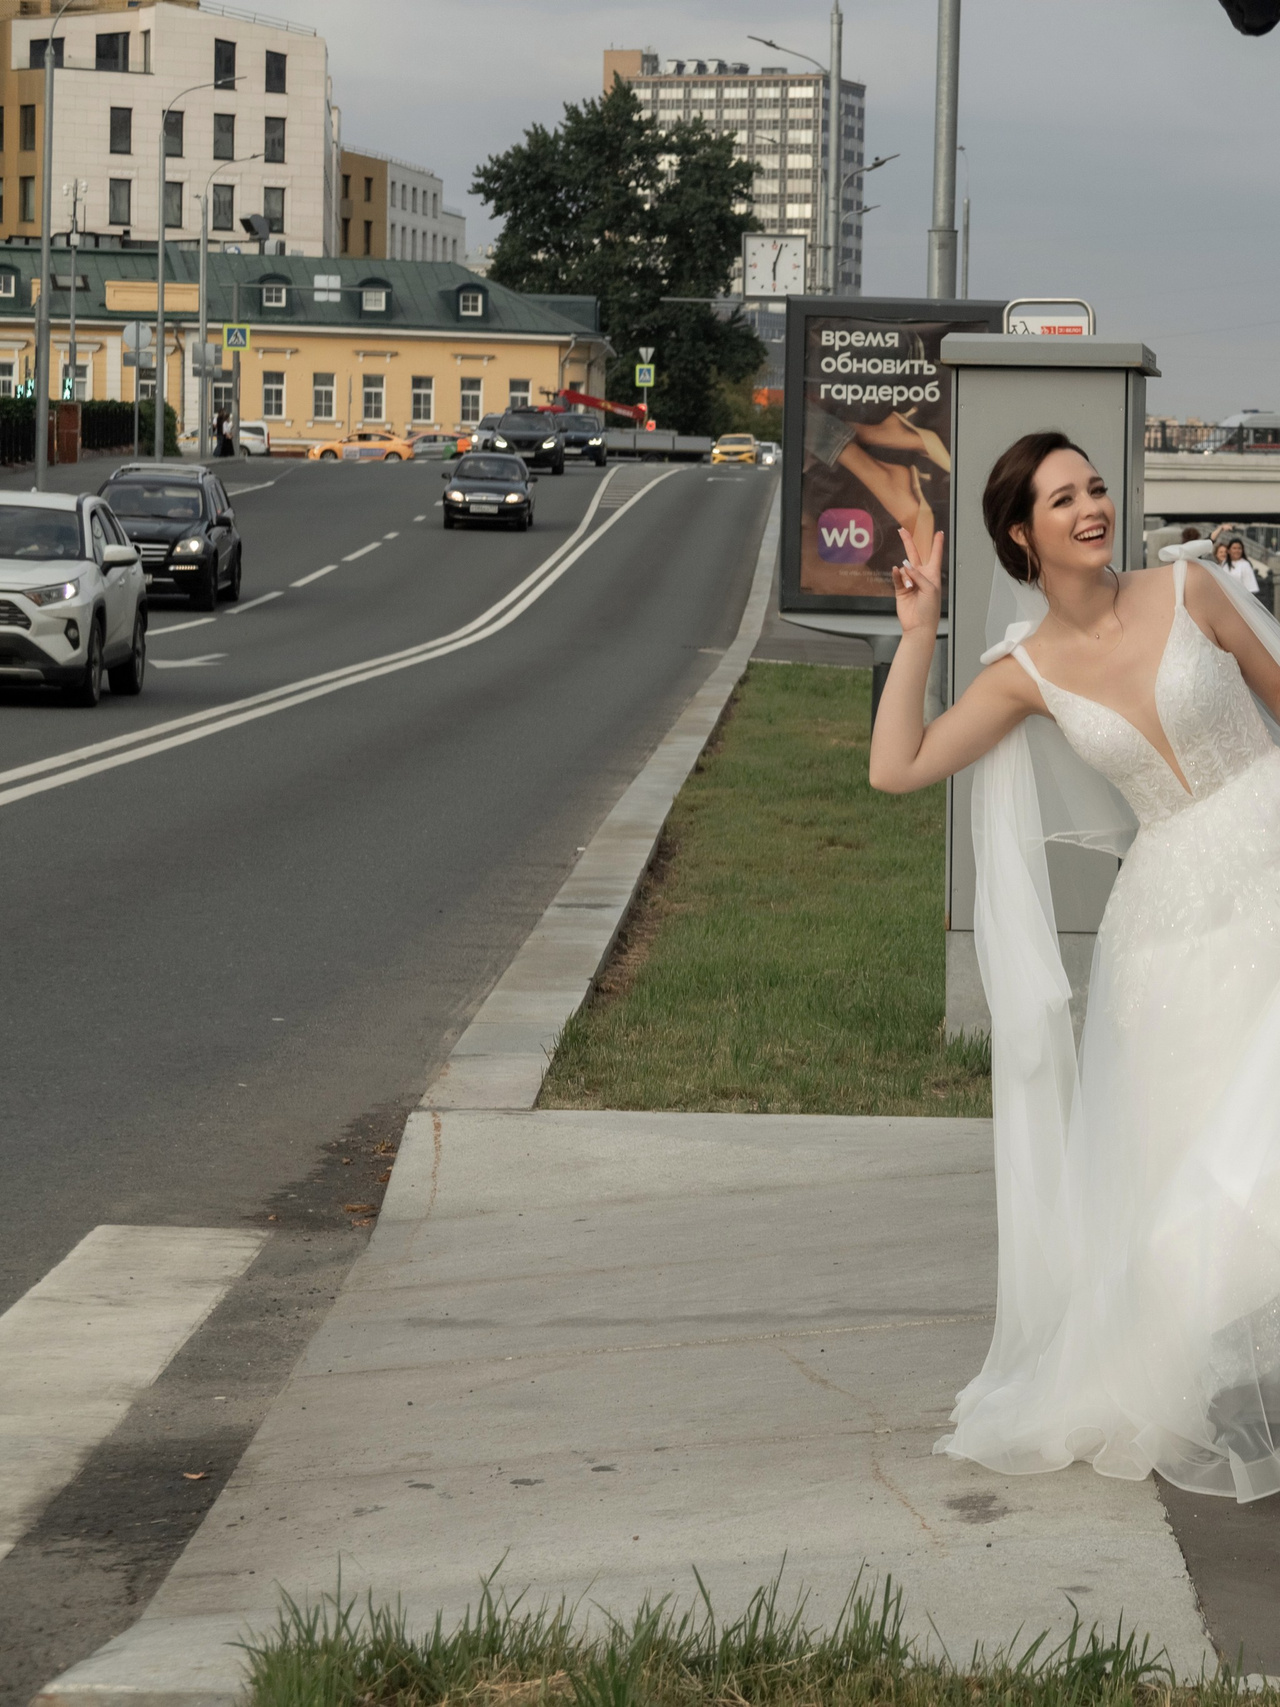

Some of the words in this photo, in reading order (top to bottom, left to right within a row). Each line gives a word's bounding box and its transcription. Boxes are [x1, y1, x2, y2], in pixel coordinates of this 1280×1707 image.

[821, 330, 899, 351] время
[820, 352, 937, 375] обновить
[820, 381, 940, 406] гардероб
[821, 519, 870, 549] wb
